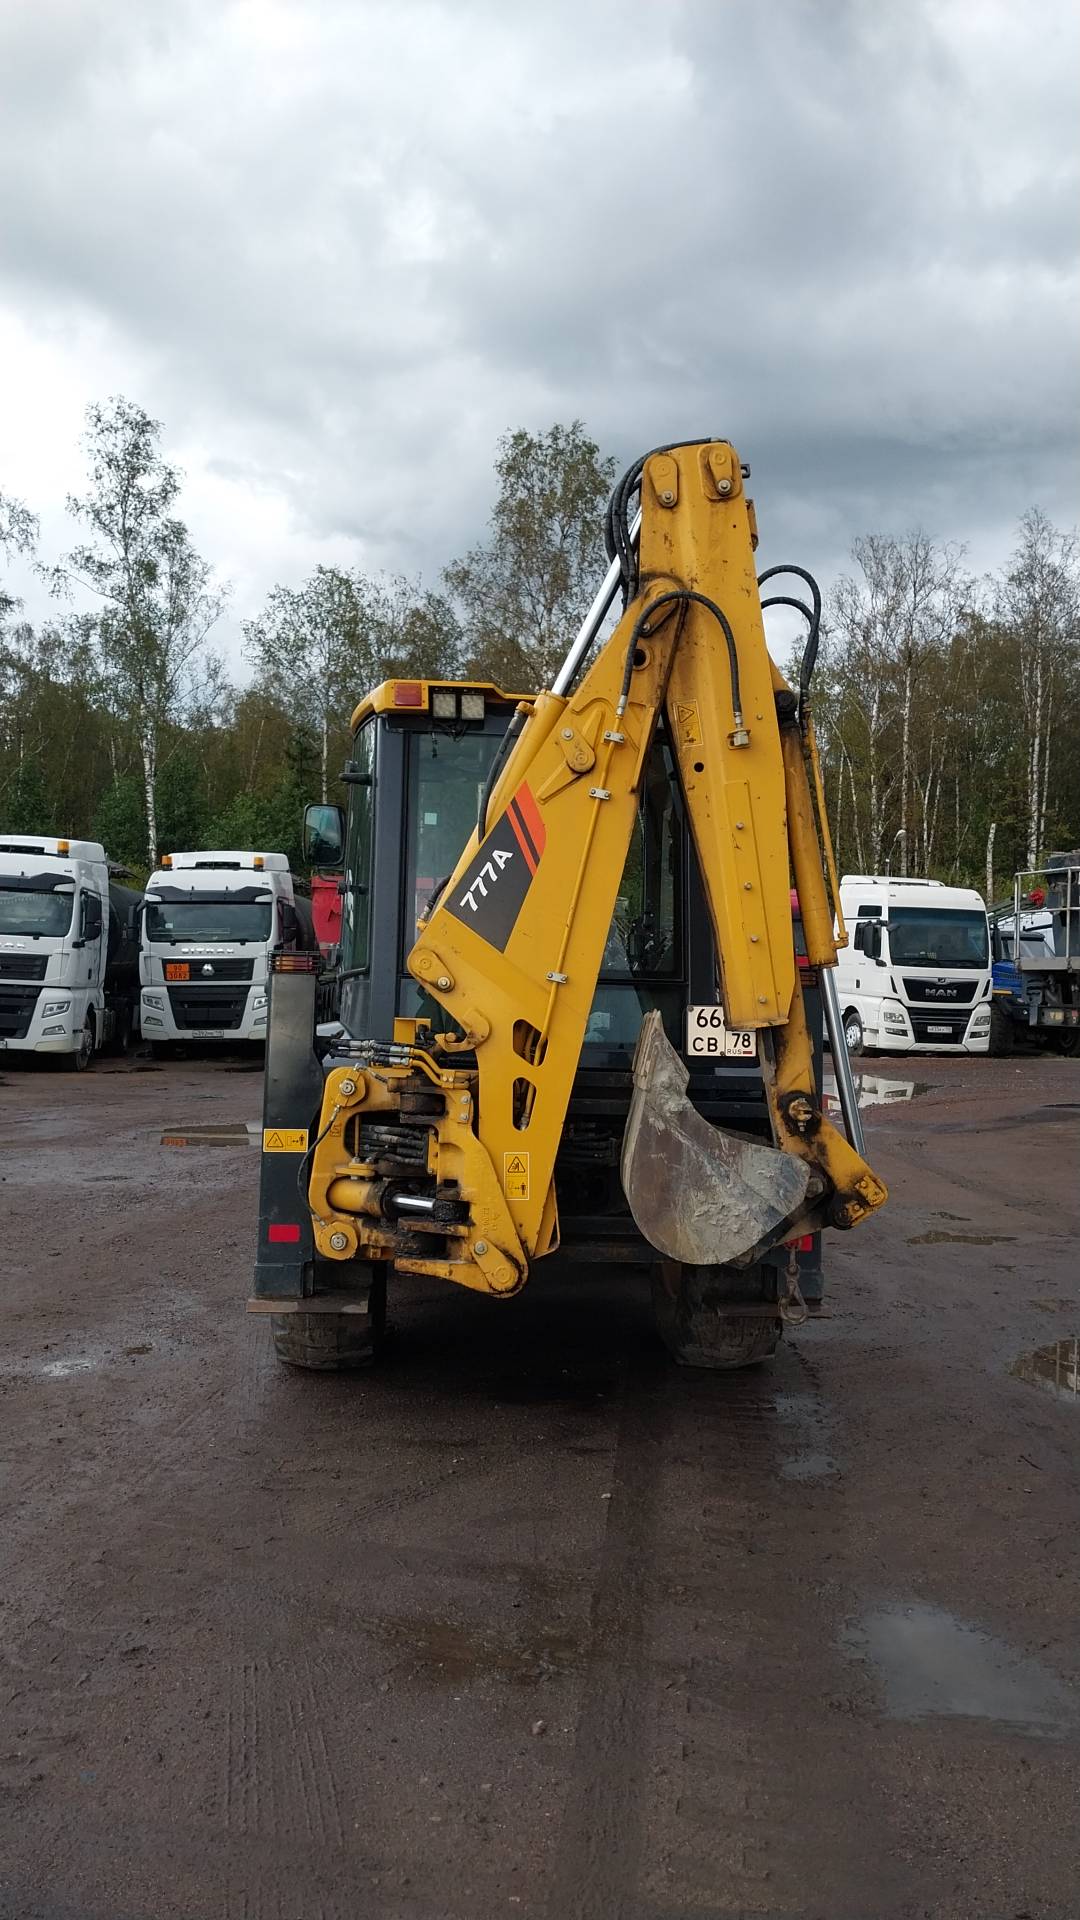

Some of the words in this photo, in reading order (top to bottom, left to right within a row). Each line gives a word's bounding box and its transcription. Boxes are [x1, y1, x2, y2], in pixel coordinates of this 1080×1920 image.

[459, 849, 514, 912] 777A
[925, 988, 958, 997] MAN
[696, 1008, 726, 1028] 66
[731, 1033, 751, 1048] 78
